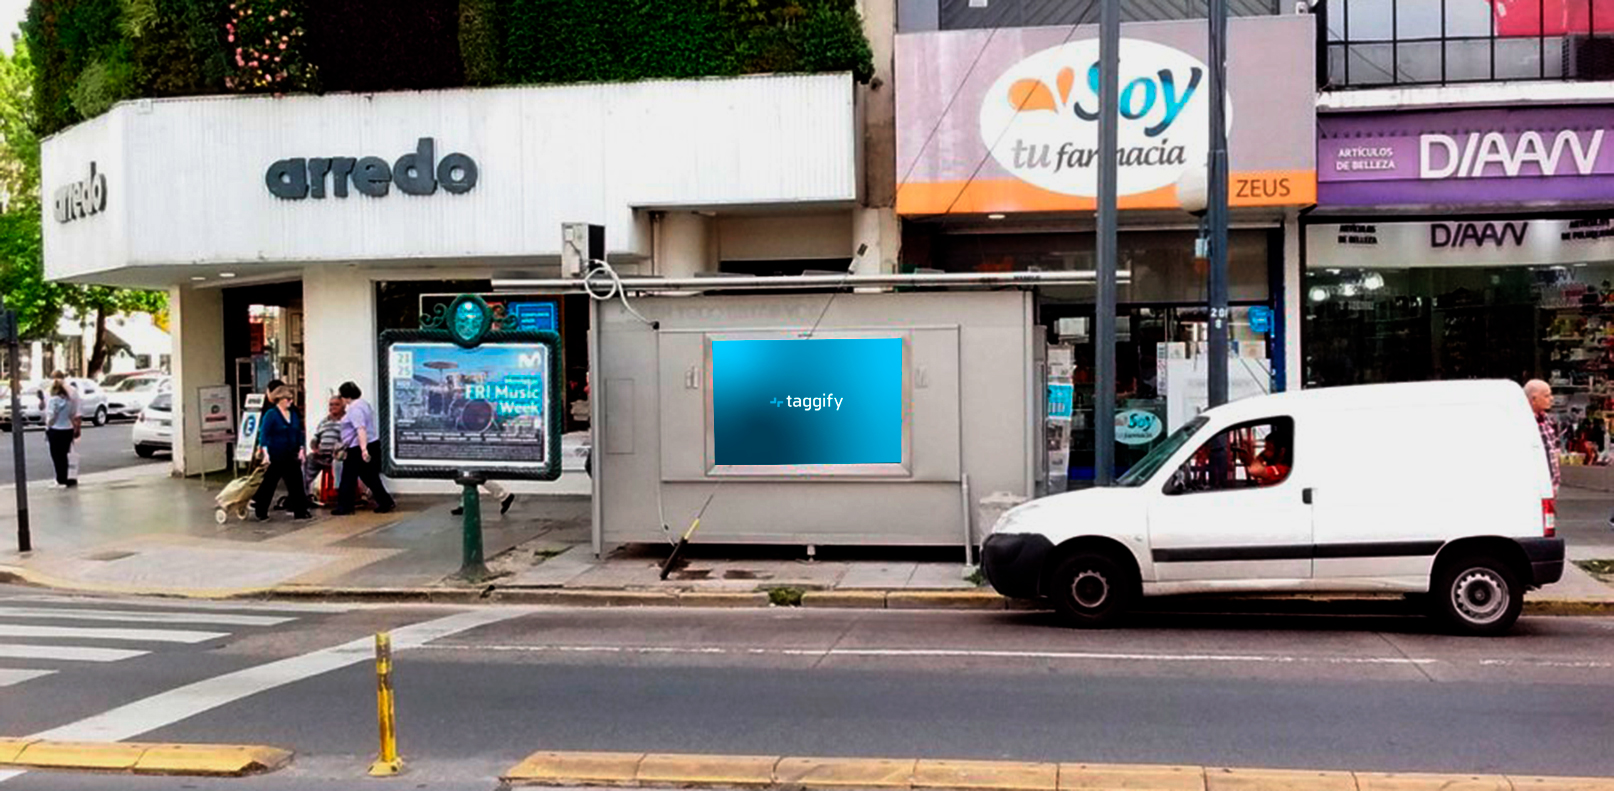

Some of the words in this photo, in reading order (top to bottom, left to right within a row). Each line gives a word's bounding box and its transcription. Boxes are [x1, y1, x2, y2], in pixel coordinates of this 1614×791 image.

[1074, 59, 1203, 137] Soy
[1012, 139, 1051, 169] tu
[1338, 147, 1394, 158] ARTÍCULOS
[265, 137, 478, 200] arredo
[1336, 161, 1350, 171] DE
[1352, 160, 1396, 170] BELLEZA
[54, 160, 107, 224] arredo
[1236, 178, 1291, 198] ZEUS
[495, 382, 540, 399] Music
[499, 400, 540, 416] Week
[786, 393, 844, 411] taggify
